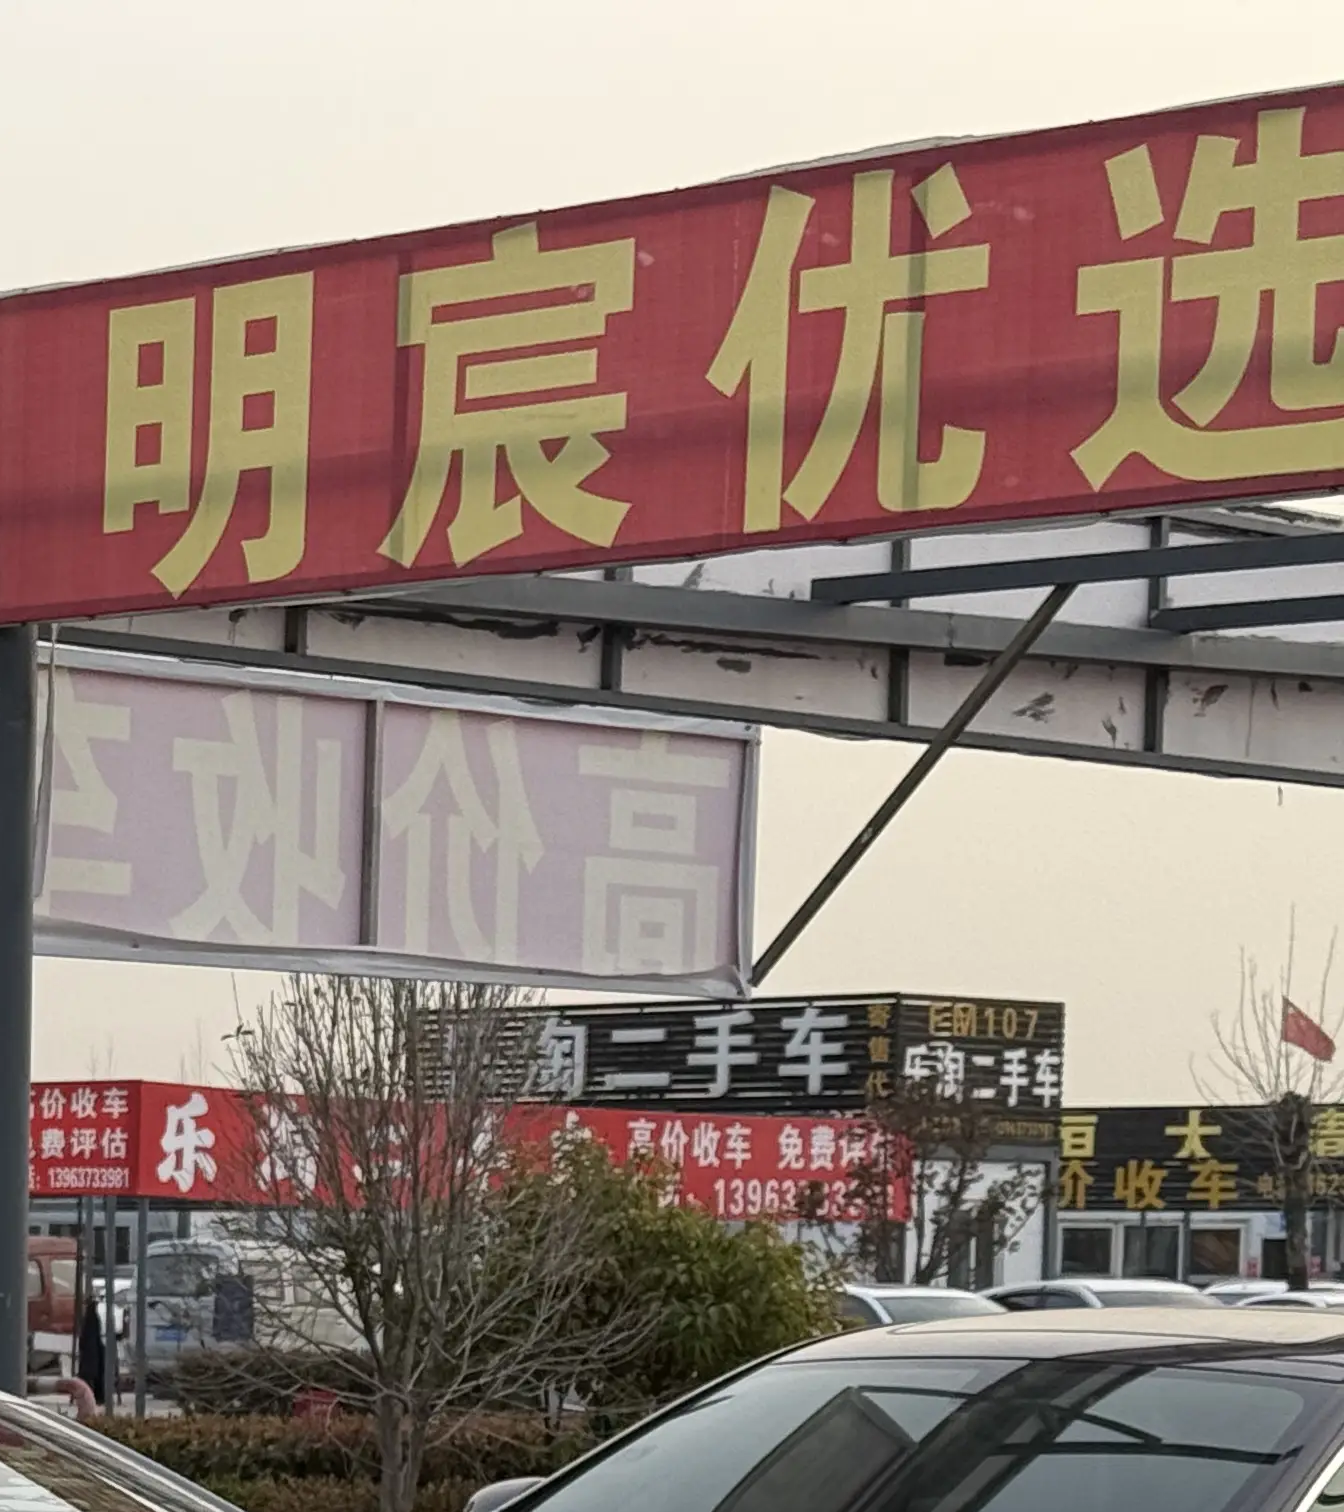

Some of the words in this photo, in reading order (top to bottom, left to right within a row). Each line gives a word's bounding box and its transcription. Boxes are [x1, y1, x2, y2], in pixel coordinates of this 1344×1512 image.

[102, 106, 1344, 598] 明宸优选
[440, 1007, 850, 1098] 淘二手车
[29, 1087, 129, 1120] 价收车
[29, 1126, 129, 1160] 费评估
[626, 1117, 753, 1170] 高价收车
